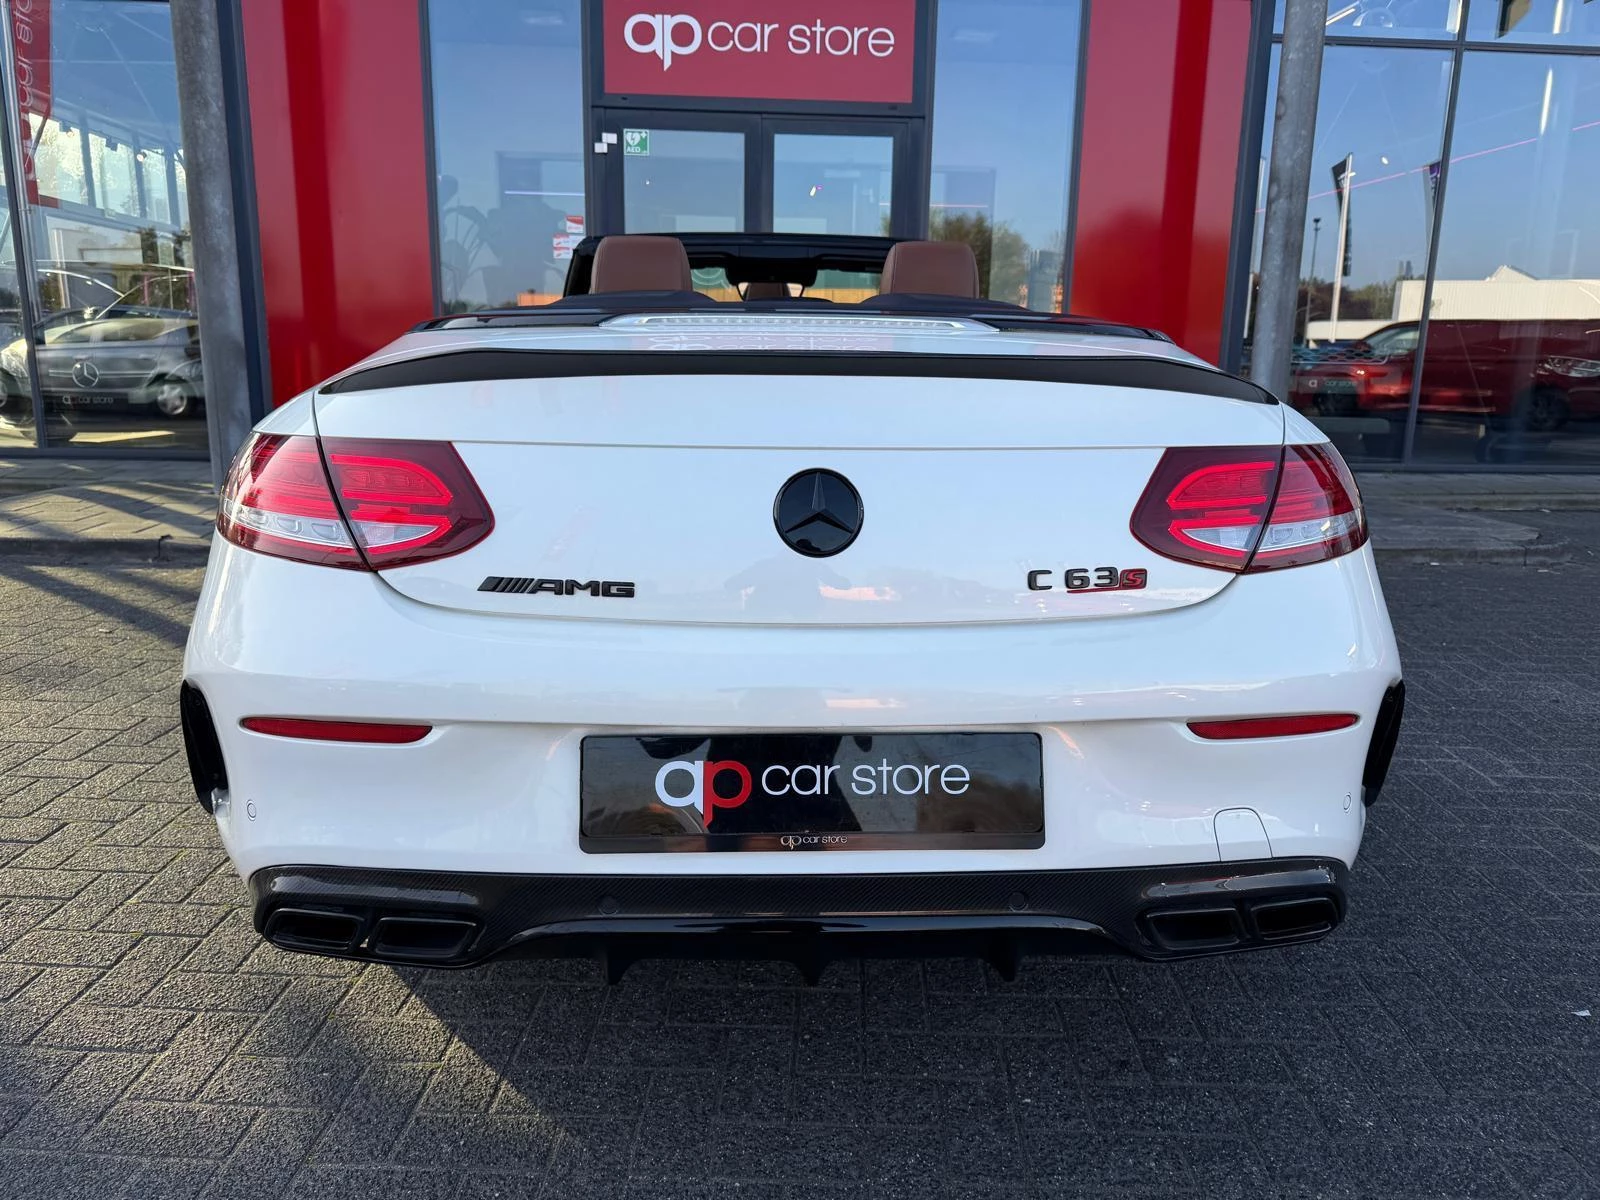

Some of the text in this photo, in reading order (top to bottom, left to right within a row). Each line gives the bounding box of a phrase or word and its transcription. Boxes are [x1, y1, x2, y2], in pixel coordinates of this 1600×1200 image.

[624, 13, 895, 71] ap car store
[527, 578, 635, 598] AMG
[1027, 569, 1053, 591] C
[655, 758, 970, 828] ap car store
[802, 836, 820, 844] car
[822, 835, 848, 844] store
